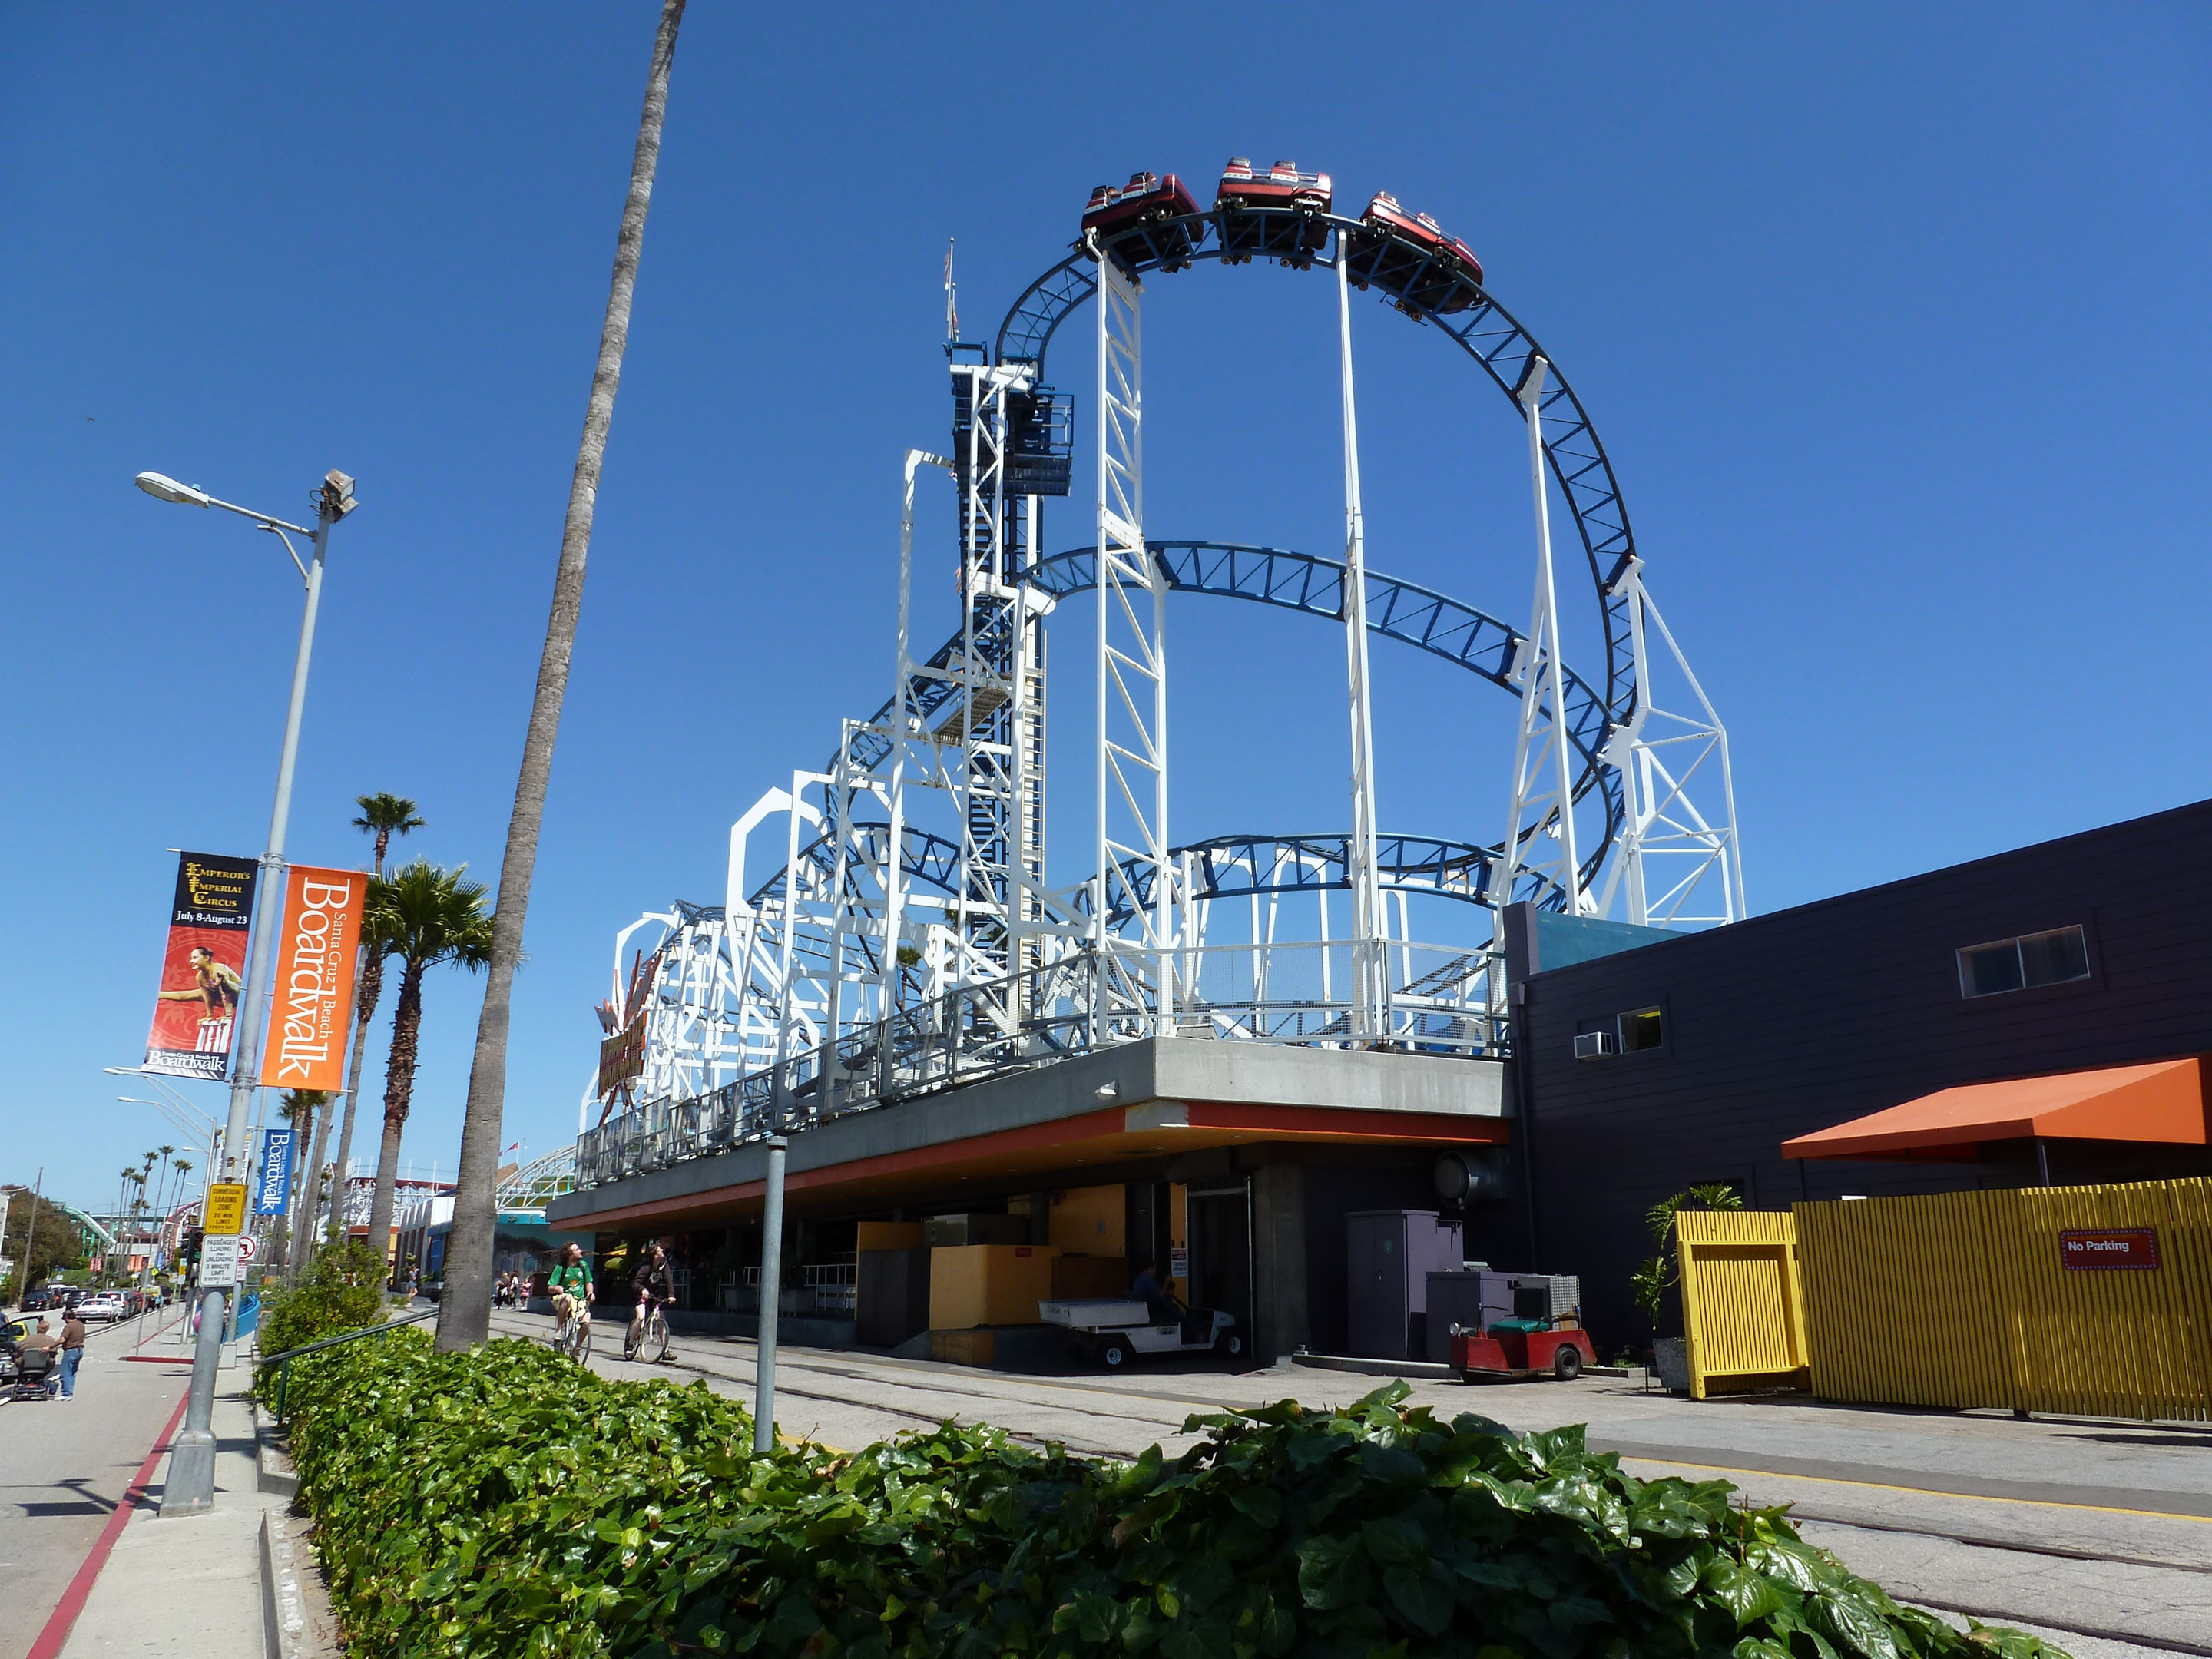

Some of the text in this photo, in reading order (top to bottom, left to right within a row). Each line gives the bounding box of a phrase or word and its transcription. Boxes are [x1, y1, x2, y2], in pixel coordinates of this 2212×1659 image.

[186, 862, 250, 879] EMPEROR'S
[188, 876, 243, 893] IMPERIAL
[194, 891, 237, 907] CIRCUS
[175, 910, 247, 925] July 8-August 23
[277, 876, 351, 1080] Boardwalk
[319, 912, 347, 1039] Santa Cruz Beach
[147, 1049, 226, 1071] Boardwalk
[261, 1131, 290, 1212] Boardwalk
[2067, 1240, 2130, 1253] No Parking
